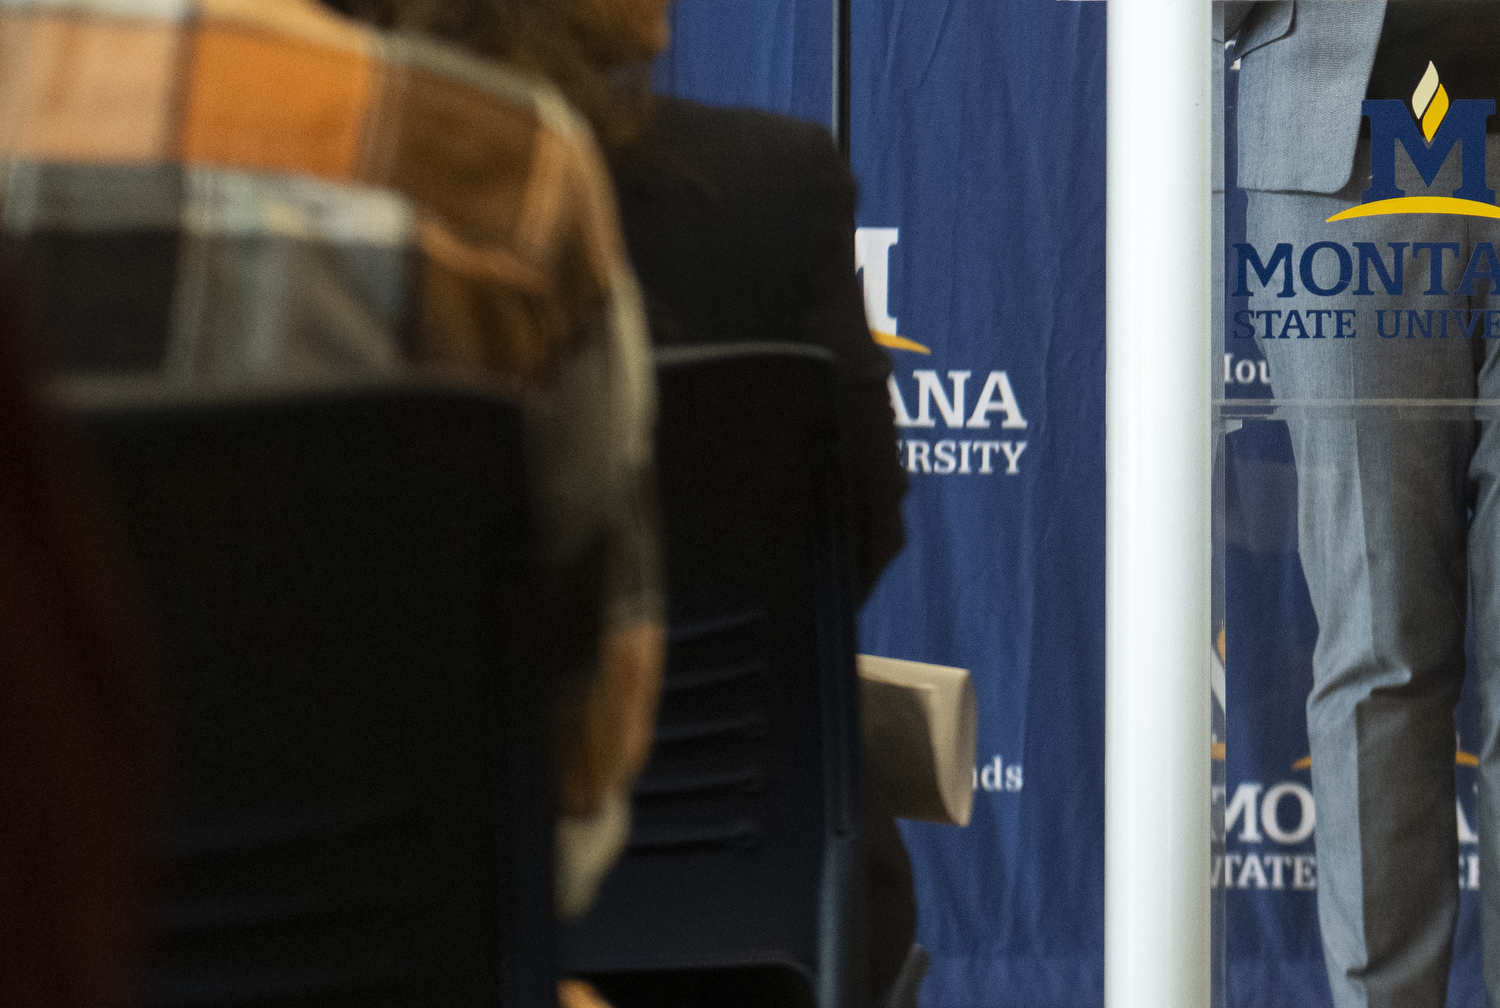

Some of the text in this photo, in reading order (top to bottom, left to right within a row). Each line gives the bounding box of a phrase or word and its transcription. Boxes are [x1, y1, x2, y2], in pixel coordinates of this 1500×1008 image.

[1361, 99, 1496, 204] M
[1232, 309, 1356, 340] STATE
[907, 441, 1026, 473] RSITY
